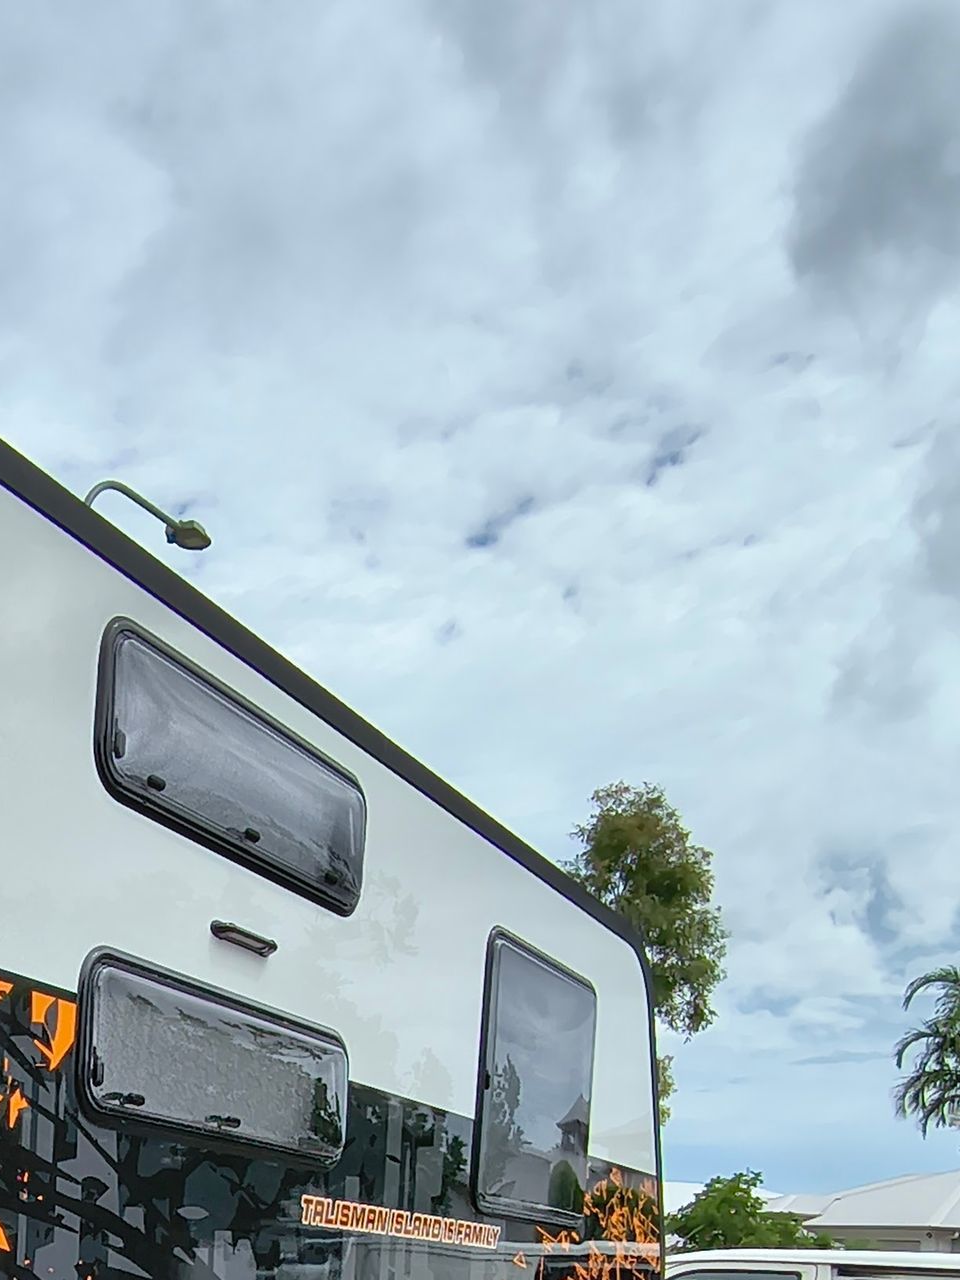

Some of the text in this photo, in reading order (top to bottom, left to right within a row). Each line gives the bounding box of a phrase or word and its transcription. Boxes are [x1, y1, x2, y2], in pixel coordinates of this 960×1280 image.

[301, 1195, 501, 1250] TALISMAN ISLAND 16 FAMILY
